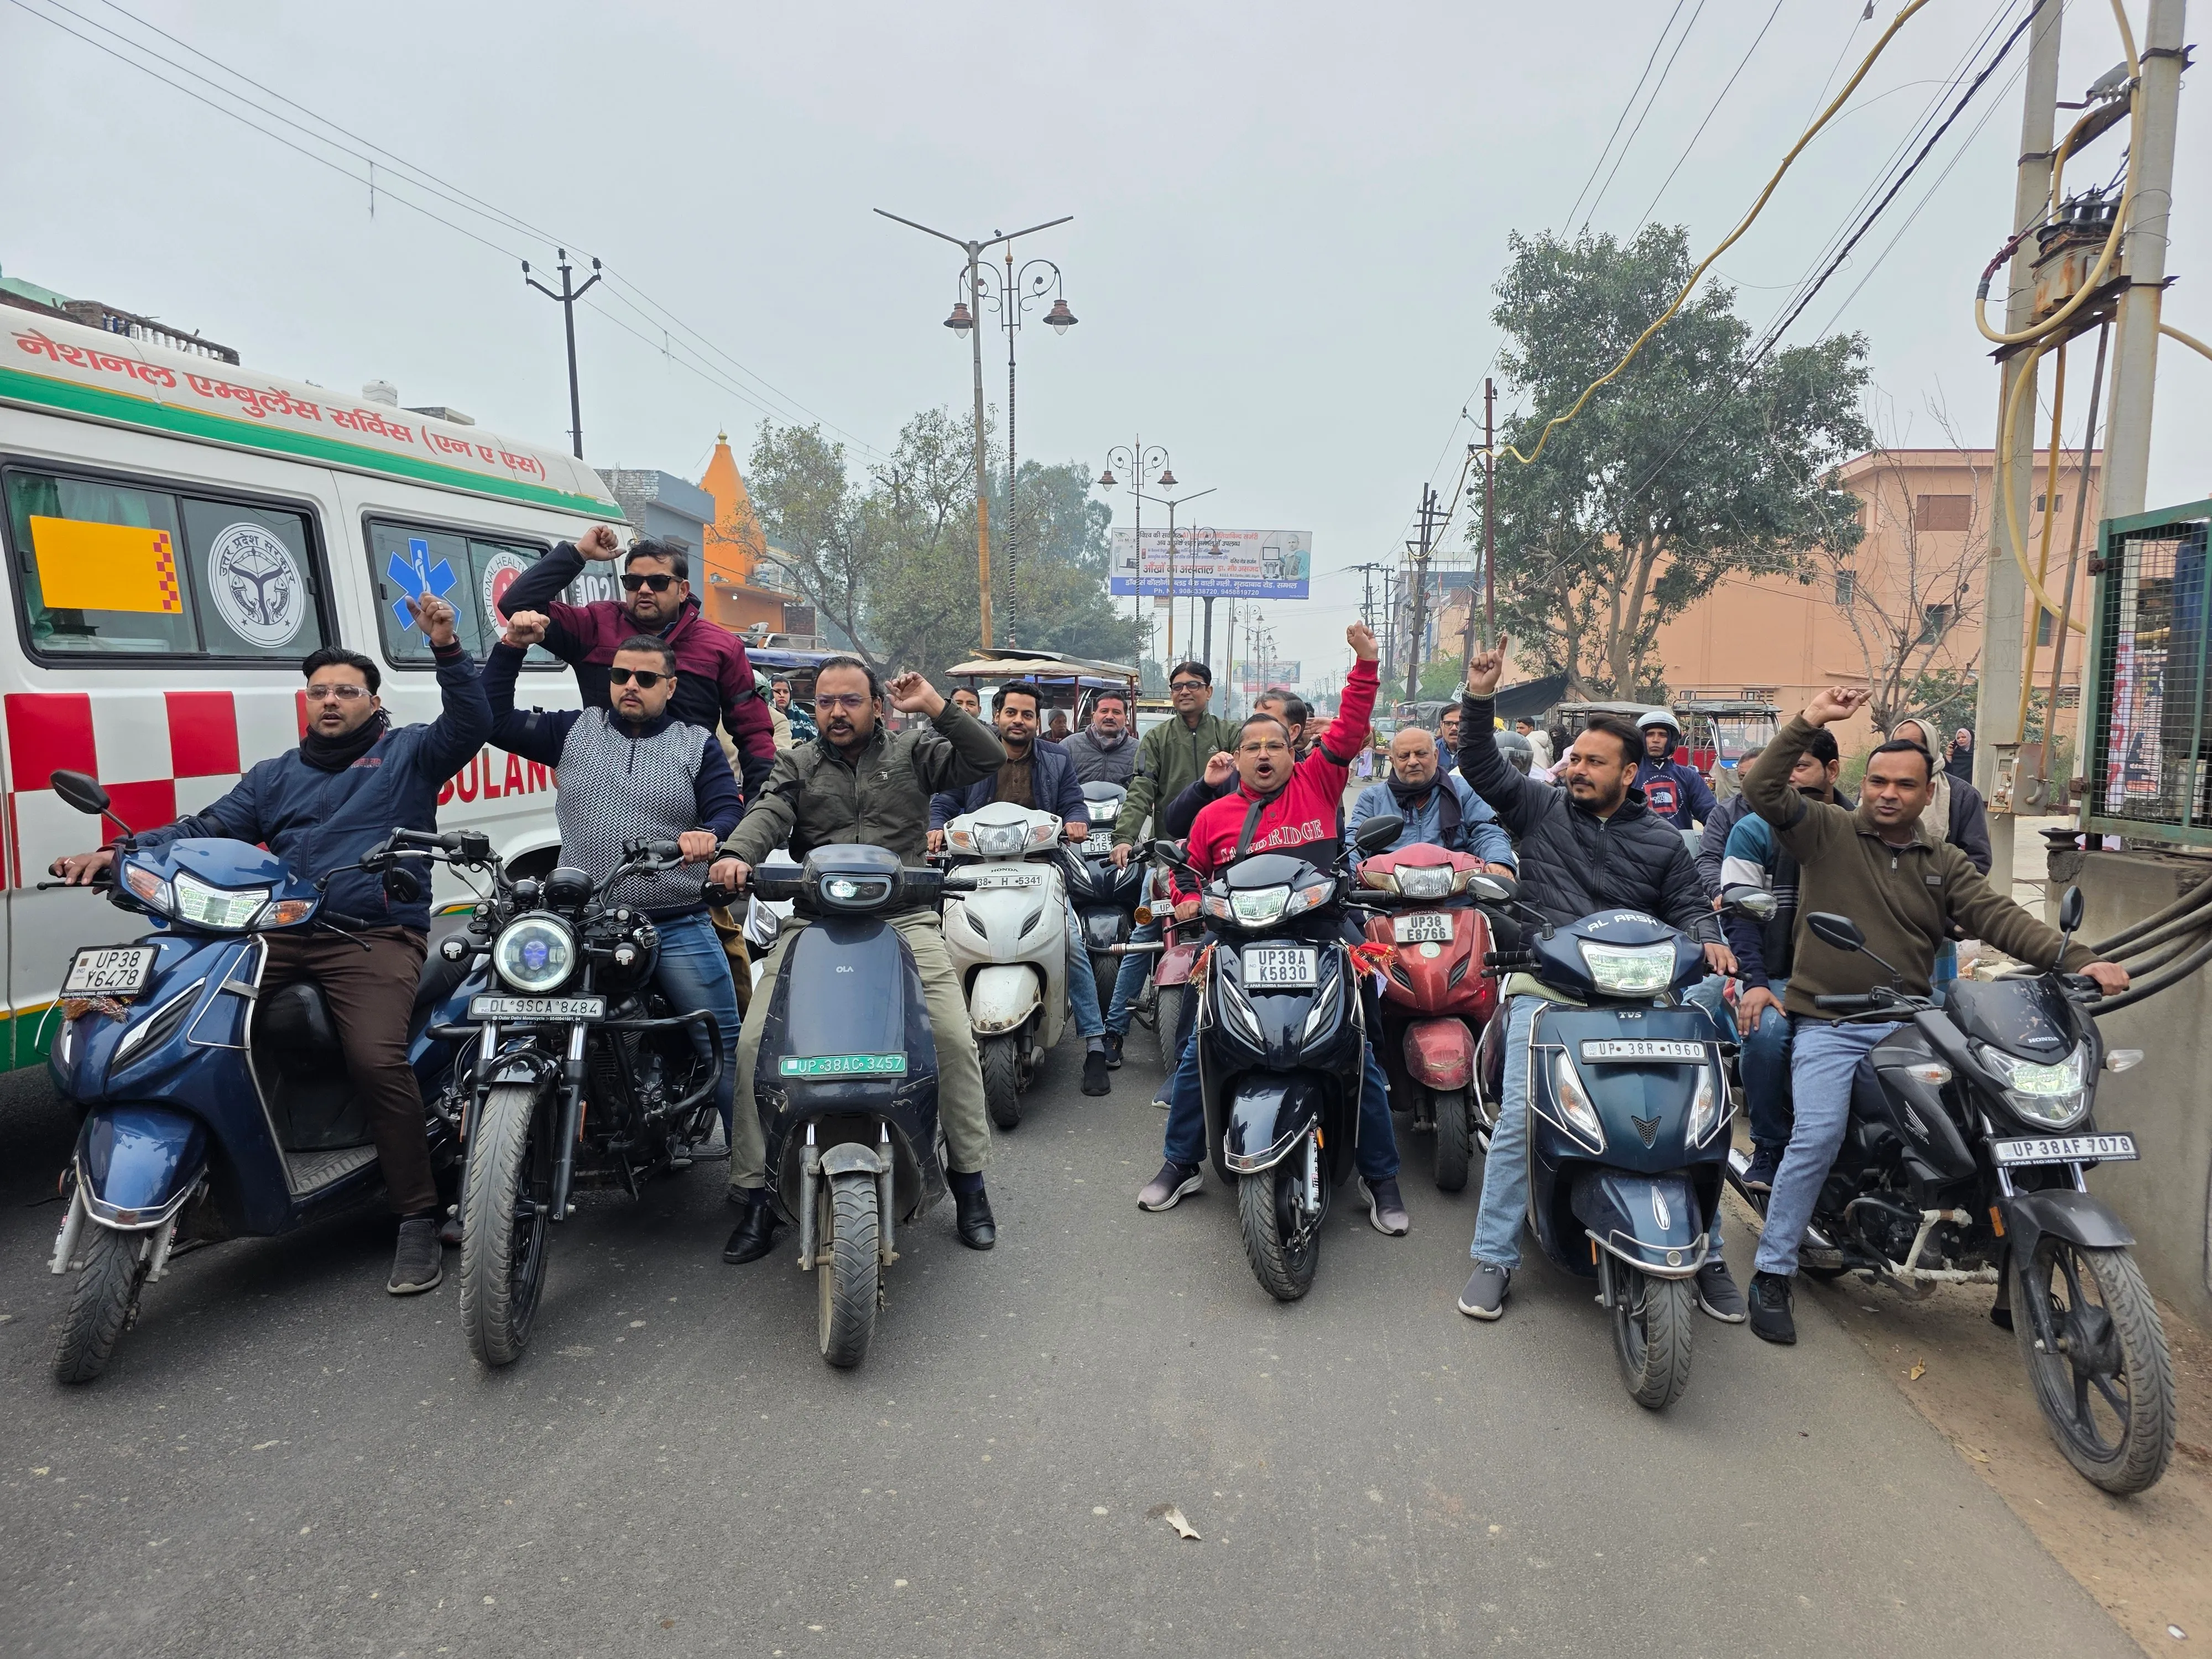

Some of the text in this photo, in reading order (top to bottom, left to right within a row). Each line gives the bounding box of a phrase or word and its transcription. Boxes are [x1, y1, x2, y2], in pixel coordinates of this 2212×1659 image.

[11, 328, 176, 388] नेशनल
[182, 372, 322, 418] एम्बुलेंस
[326, 407, 414, 443] सर्विस
[475, 445, 495, 464] ए
[220, 533, 295, 584] उत्तर प्रदेश सरकार
[484, 566, 498, 629] NATIONAL
[576, 575, 611, 607] 102
[977, 877, 1040, 886] 38 H 5341
[1160, 904, 1170, 912] UP
[1411, 916, 1442, 928] UP38
[1588, 914, 1658, 932] AL ARSH
[1407, 927, 1446, 940] E8766
[96, 951, 140, 968] UP38
[1259, 951, 1306, 966] UP38A
[86, 969, 138, 988] Y6478
[1260, 966, 1307, 980] K5830
[490, 1000, 508, 1012] DL
[561, 1001, 597, 1014] 8484
[1599, 1043, 1615, 1055] UP
[1666, 1044, 1700, 1056] 1960
[799, 1057, 903, 1073] UP 38AC 3457
[2012, 1137, 2131, 1157] UP 38AF 7078
